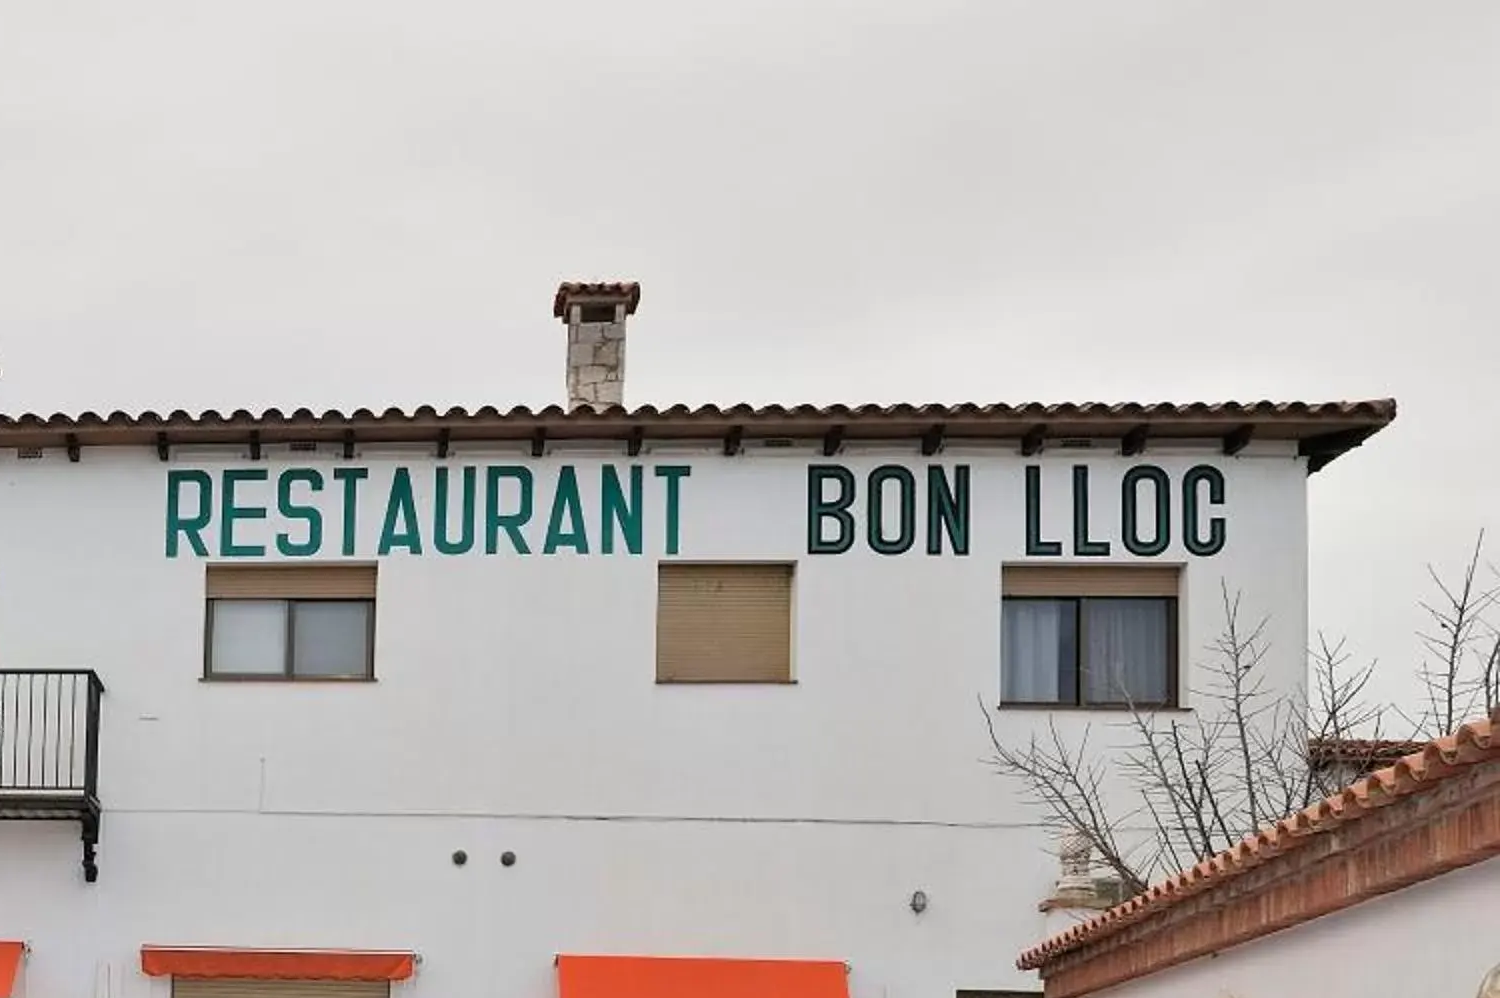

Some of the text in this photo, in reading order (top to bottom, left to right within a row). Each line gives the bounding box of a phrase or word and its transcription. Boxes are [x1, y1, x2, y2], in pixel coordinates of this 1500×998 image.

[165, 465, 1226, 557] RESTAURANT BON LLOC
